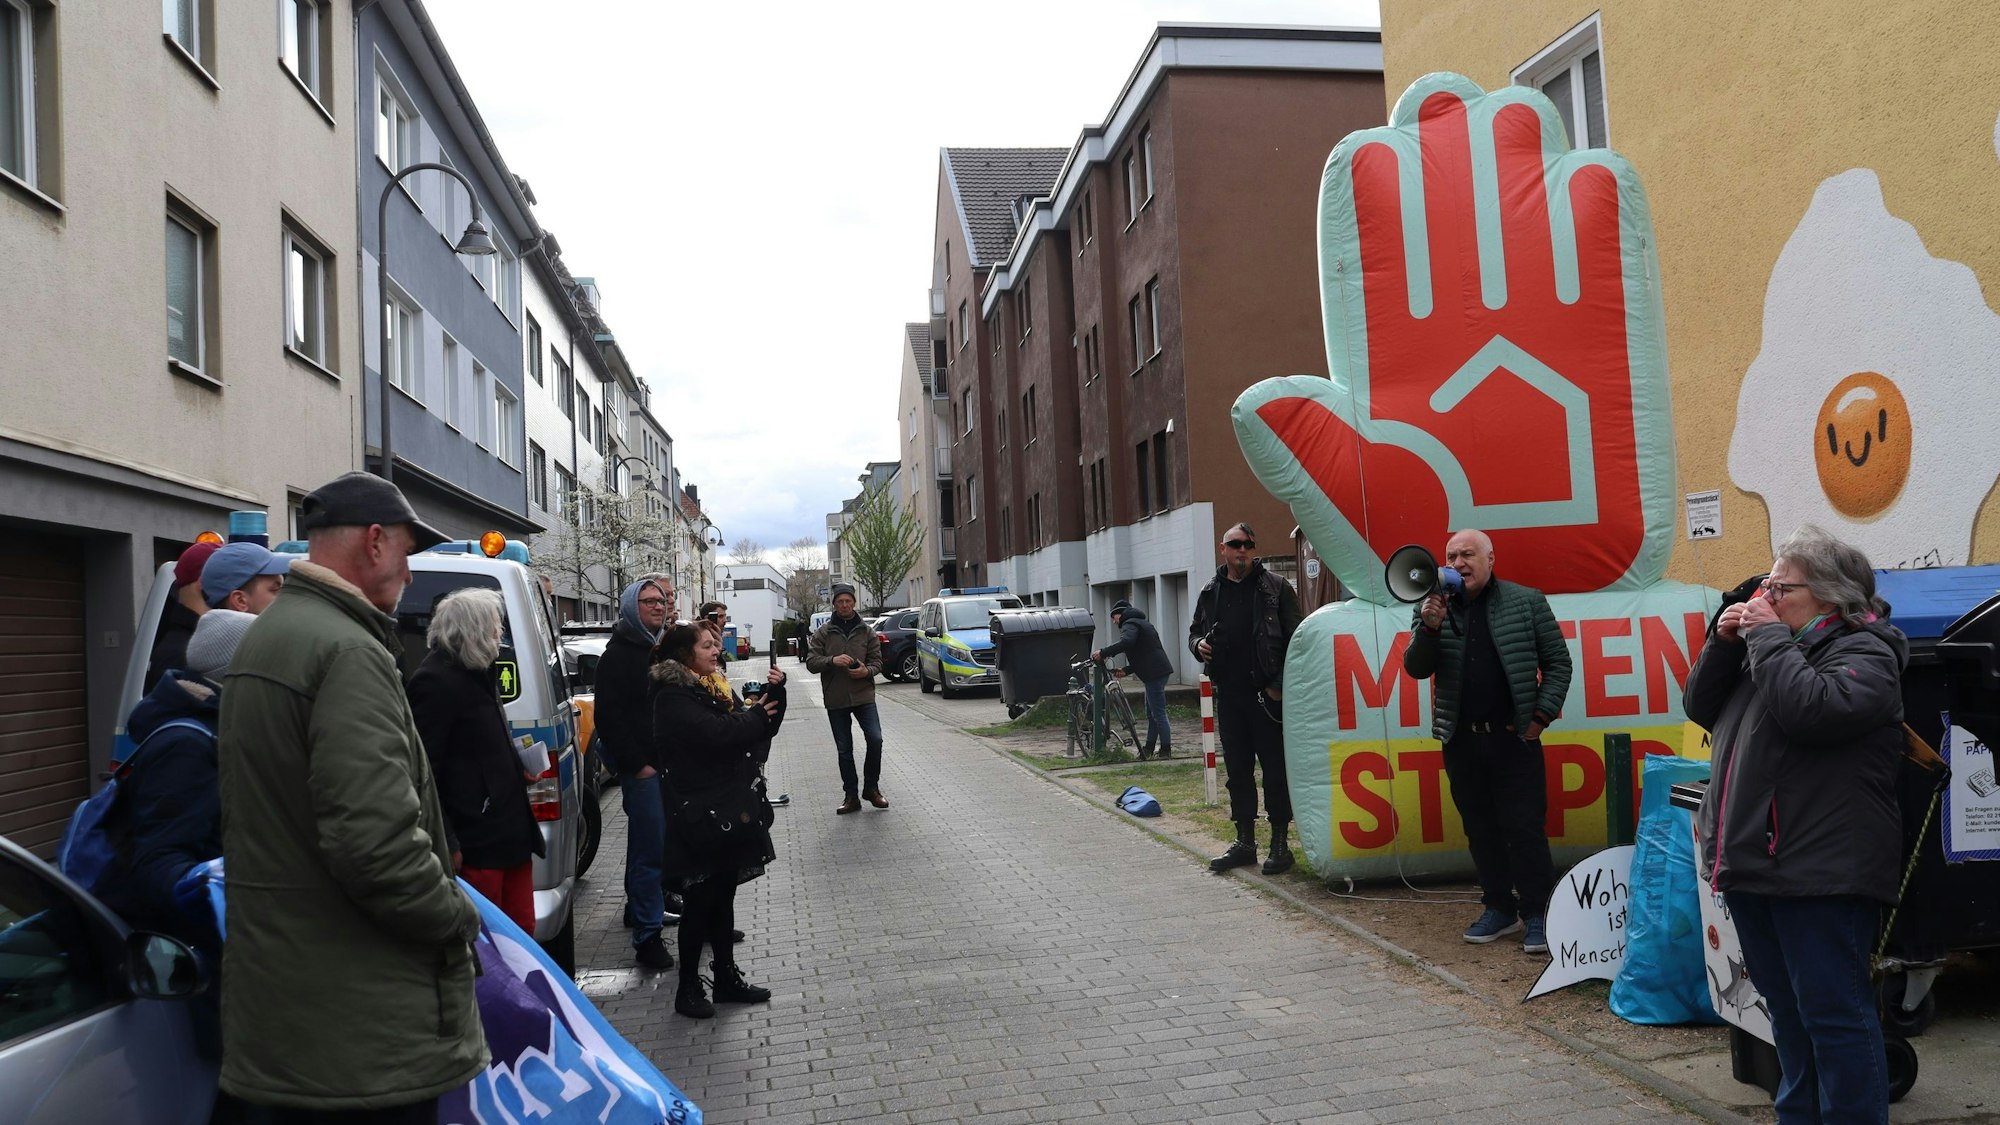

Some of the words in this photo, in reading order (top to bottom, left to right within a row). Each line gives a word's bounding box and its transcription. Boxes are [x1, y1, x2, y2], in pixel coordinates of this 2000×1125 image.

[1333, 612, 1706, 730] MEN
[1339, 740, 1677, 850] STP
[1608, 905, 1627, 932] ist
